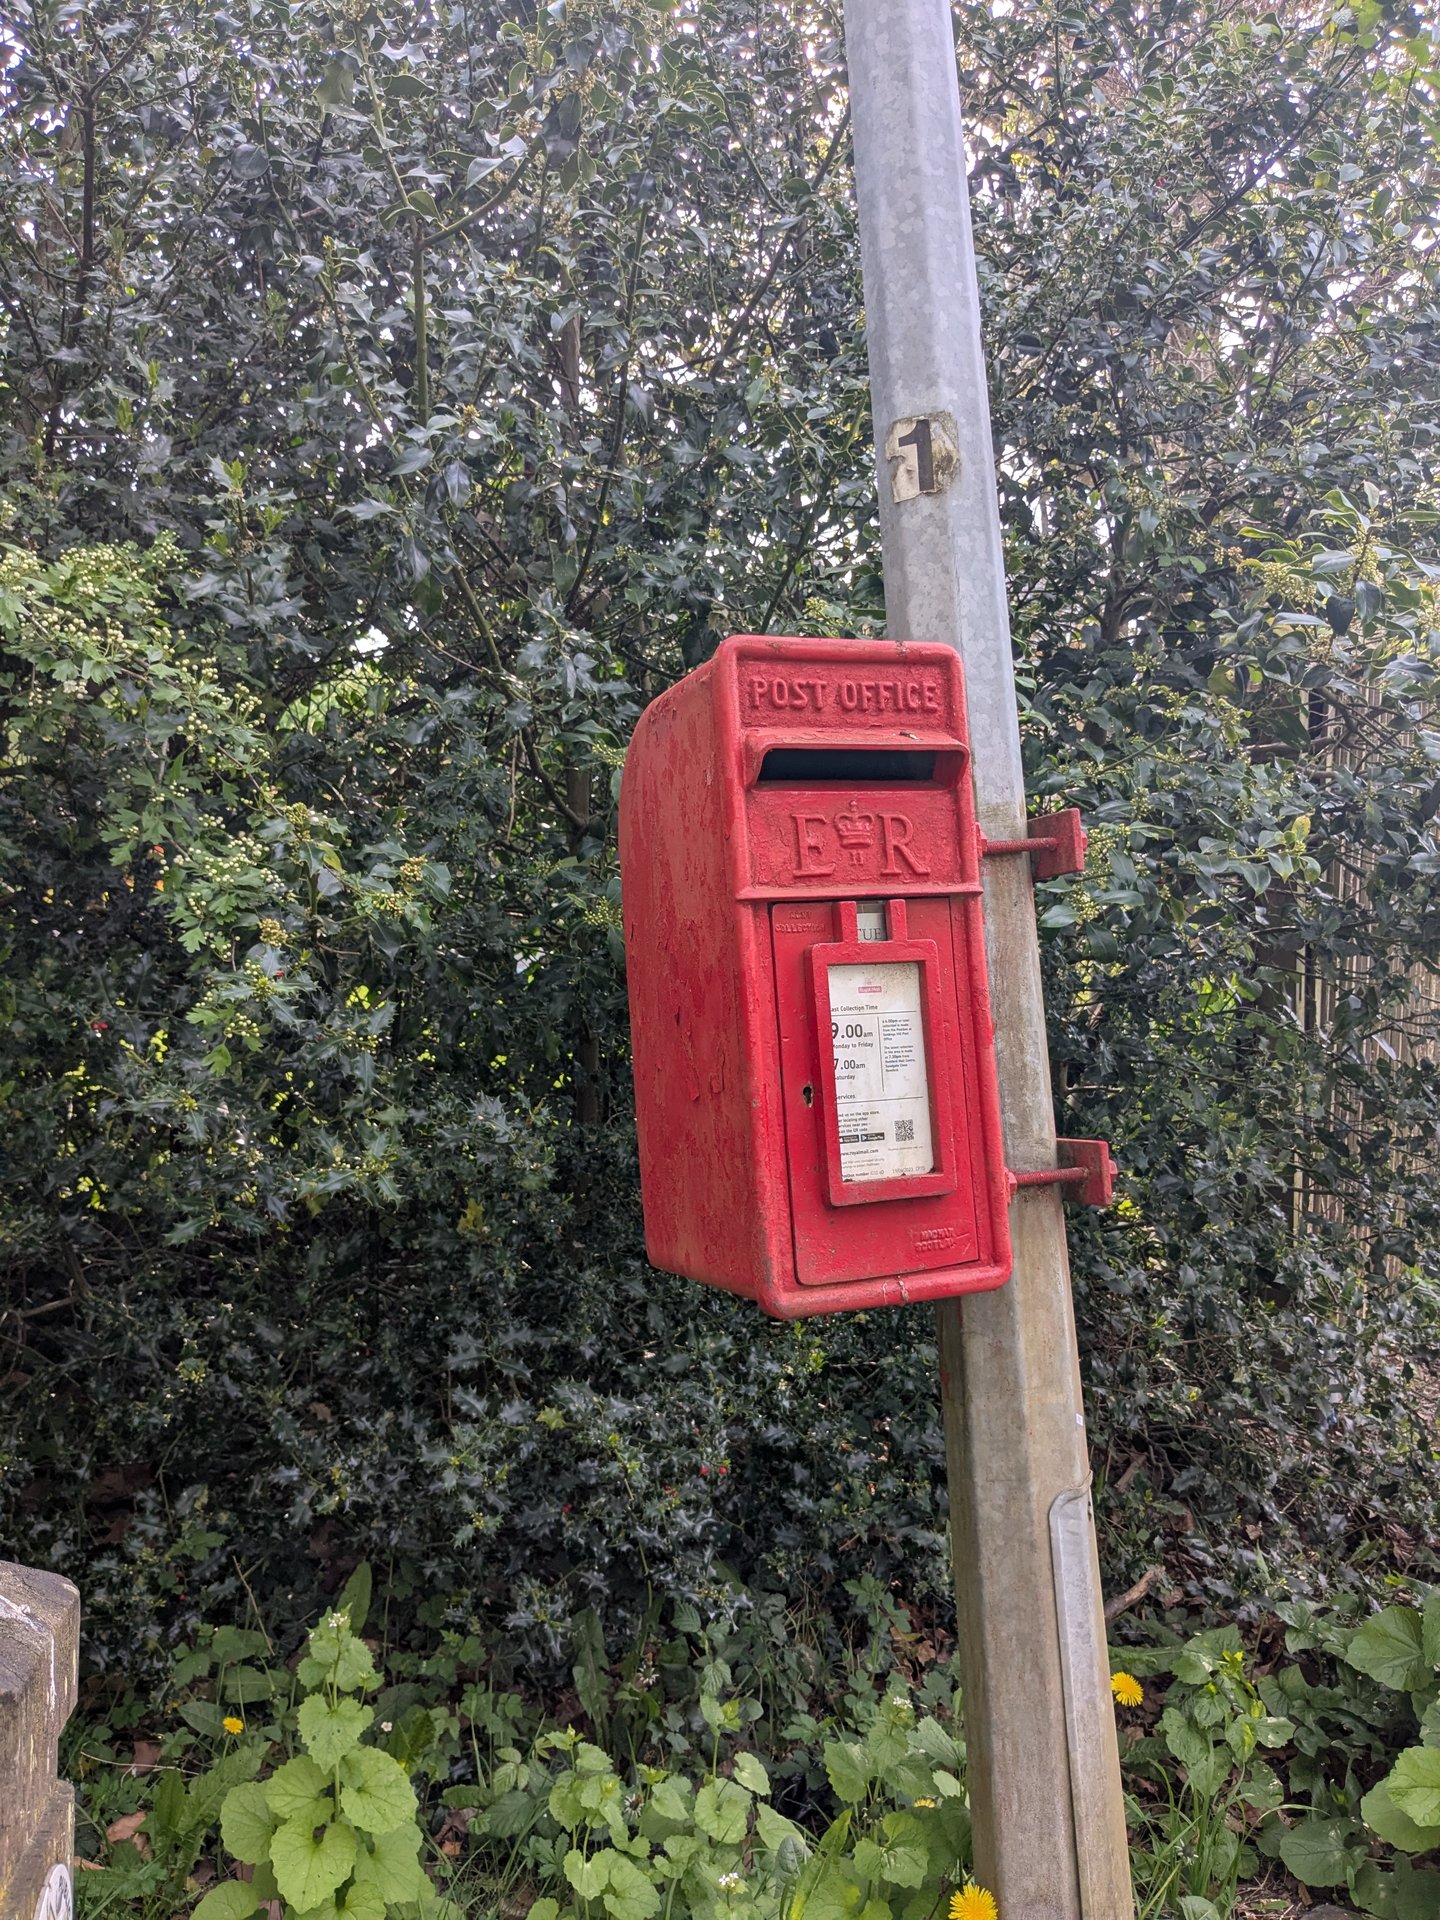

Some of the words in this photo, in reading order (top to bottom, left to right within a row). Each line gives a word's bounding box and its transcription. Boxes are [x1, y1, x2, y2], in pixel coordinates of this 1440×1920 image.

[898, 418, 935, 491] 1
[751, 676, 827, 709] POST
[840, 680, 939, 711] OFFICE
[792, 813, 836, 878] E
[878, 812, 931, 876] R
[775, 922, 825, 934] COLLECTION
[840, 1004, 864, 1012] Collection
